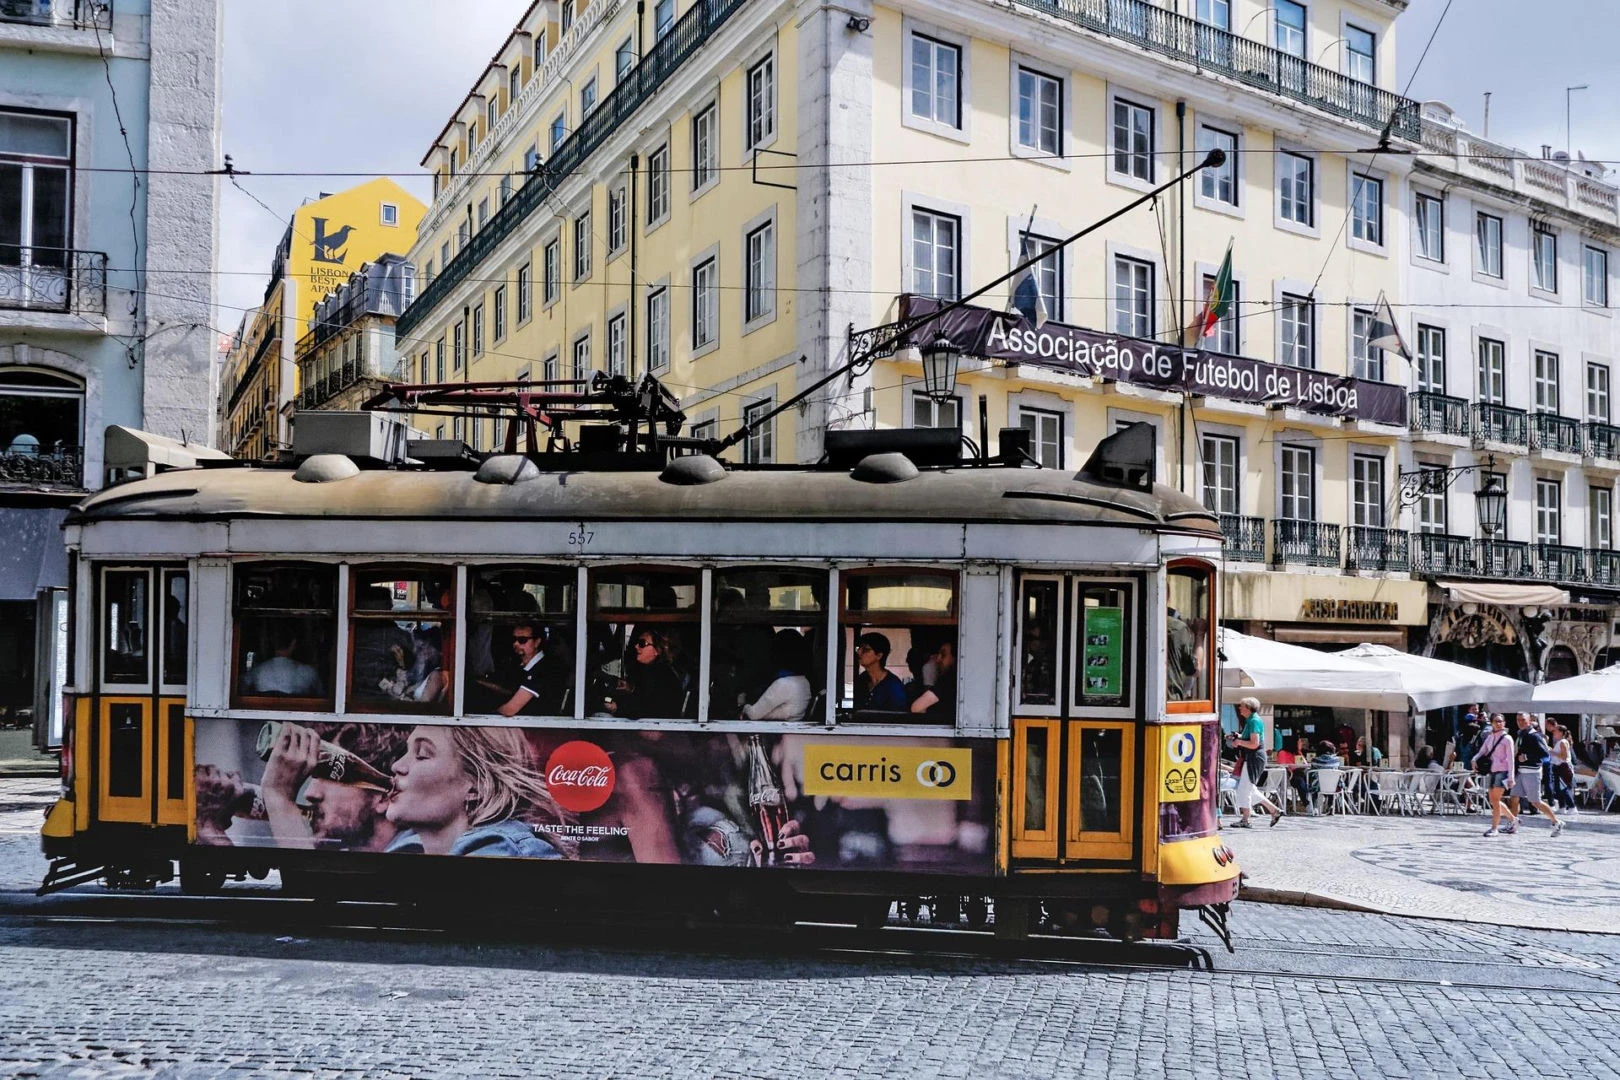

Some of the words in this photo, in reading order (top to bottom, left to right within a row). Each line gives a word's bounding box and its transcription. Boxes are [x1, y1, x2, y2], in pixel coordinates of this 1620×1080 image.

[311, 267, 348, 277] LISBON
[311, 276, 337, 285] BEST
[987, 317, 1133, 374] Associação
[1142, 346, 1172, 378] de
[1182, 352, 1259, 392] Futebol
[1265, 368, 1290, 397] de
[1297, 372, 1358, 409] Lisboa
[568, 532, 594, 545] 557
[549, 765, 613, 787] Coca-Cola
[820, 757, 902, 783] carris
[532, 824, 563, 834] TASTE
[564, 825, 584, 835] THE
[586, 826, 628, 836] FEELING
